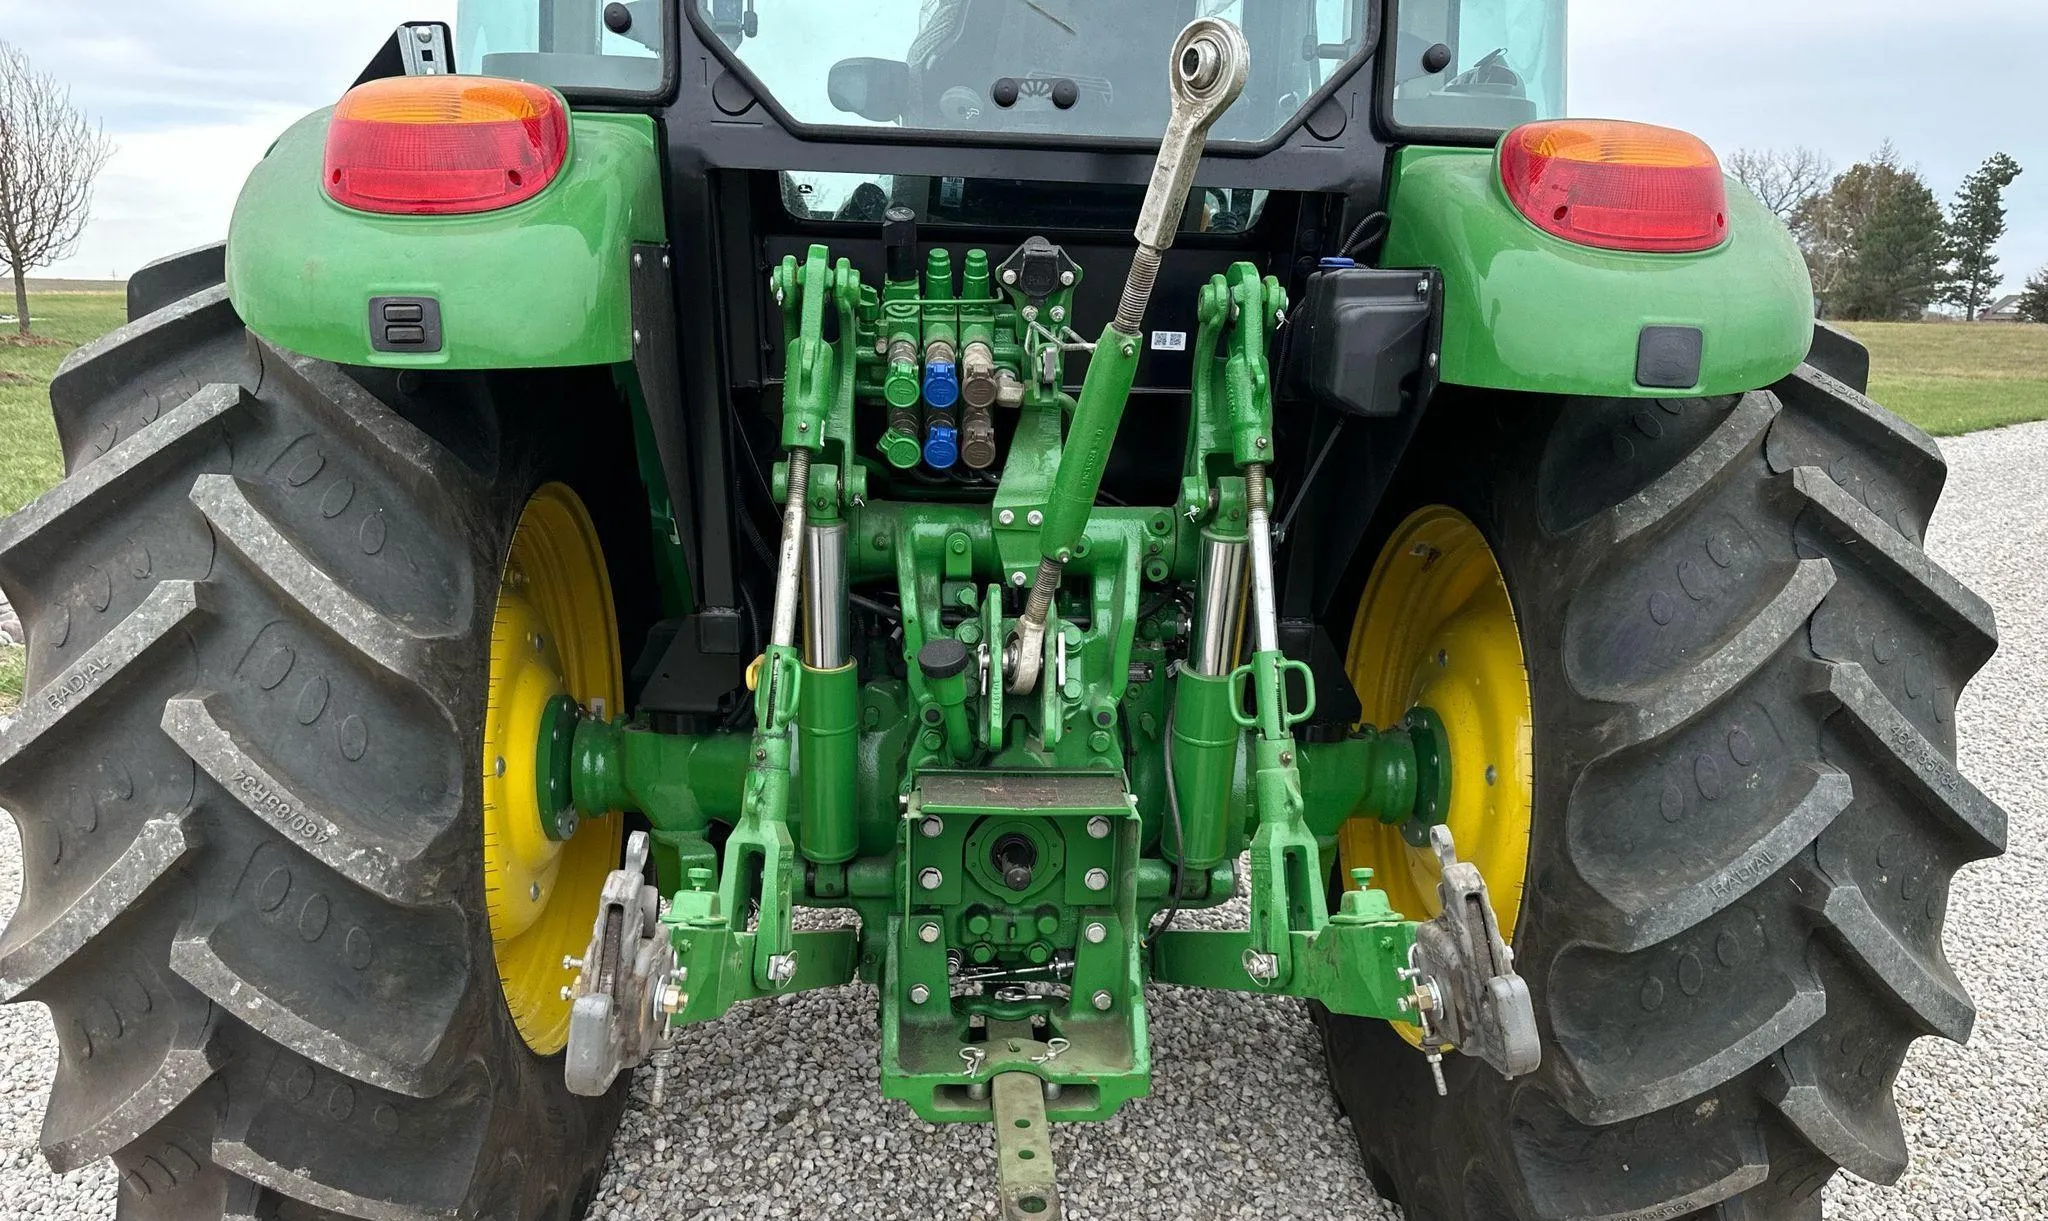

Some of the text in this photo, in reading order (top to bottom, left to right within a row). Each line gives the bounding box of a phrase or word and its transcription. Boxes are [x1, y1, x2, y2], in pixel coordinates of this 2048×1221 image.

[46, 655, 112, 710] RADIAL
[231, 768, 330, 844] 460/85R34
[1708, 849, 1777, 899] RADIAL
